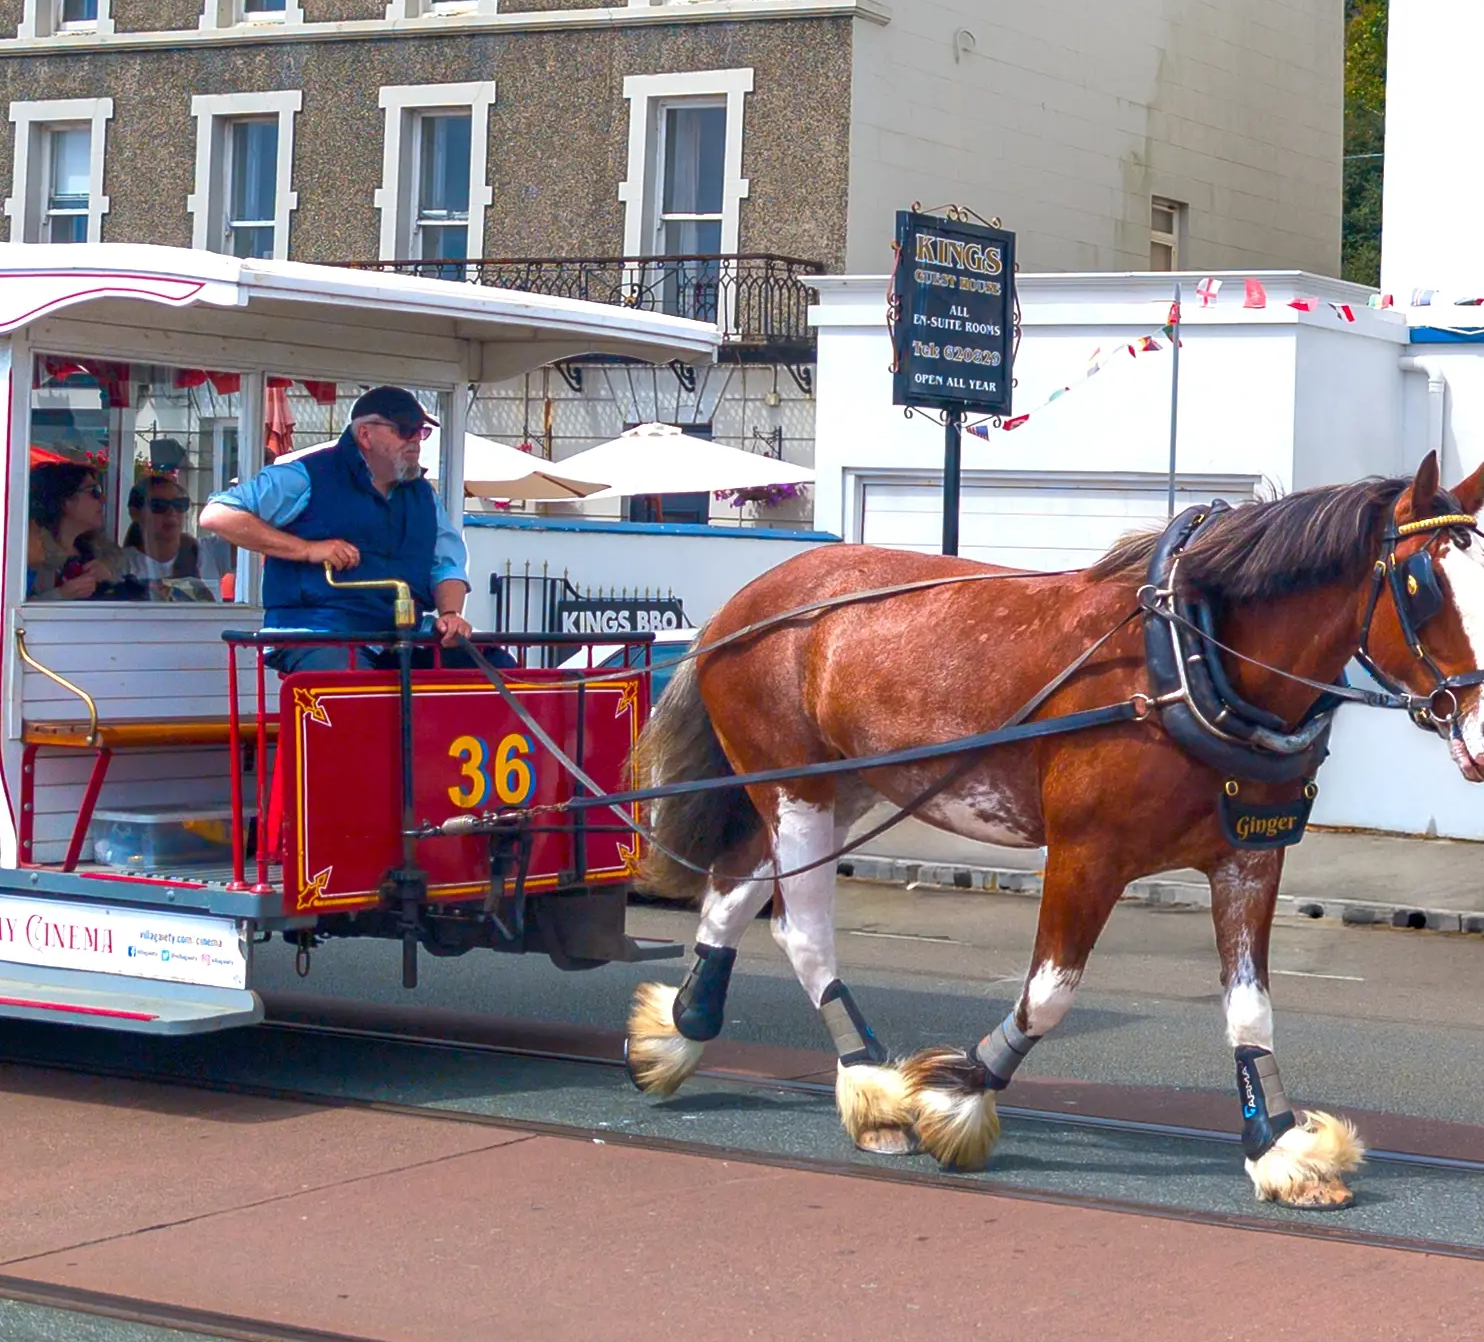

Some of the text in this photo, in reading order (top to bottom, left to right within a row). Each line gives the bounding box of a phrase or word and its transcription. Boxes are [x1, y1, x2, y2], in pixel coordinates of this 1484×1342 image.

[915, 233, 1002, 275] KINGS
[914, 269, 1002, 296] GUEST HOUSE
[949, 305, 970, 318] ALL
[913, 314, 1001, 336] EN-SUITE ROOMS
[912, 340, 1001, 366] Tel: 620829
[915, 373, 997, 392] OPEN ALL YEAR
[562, 610, 631, 633] KINGS
[447, 733, 536, 809] 36
[1236, 815, 1297, 840] Ginger
[26, 914, 113, 954] CINEMA
